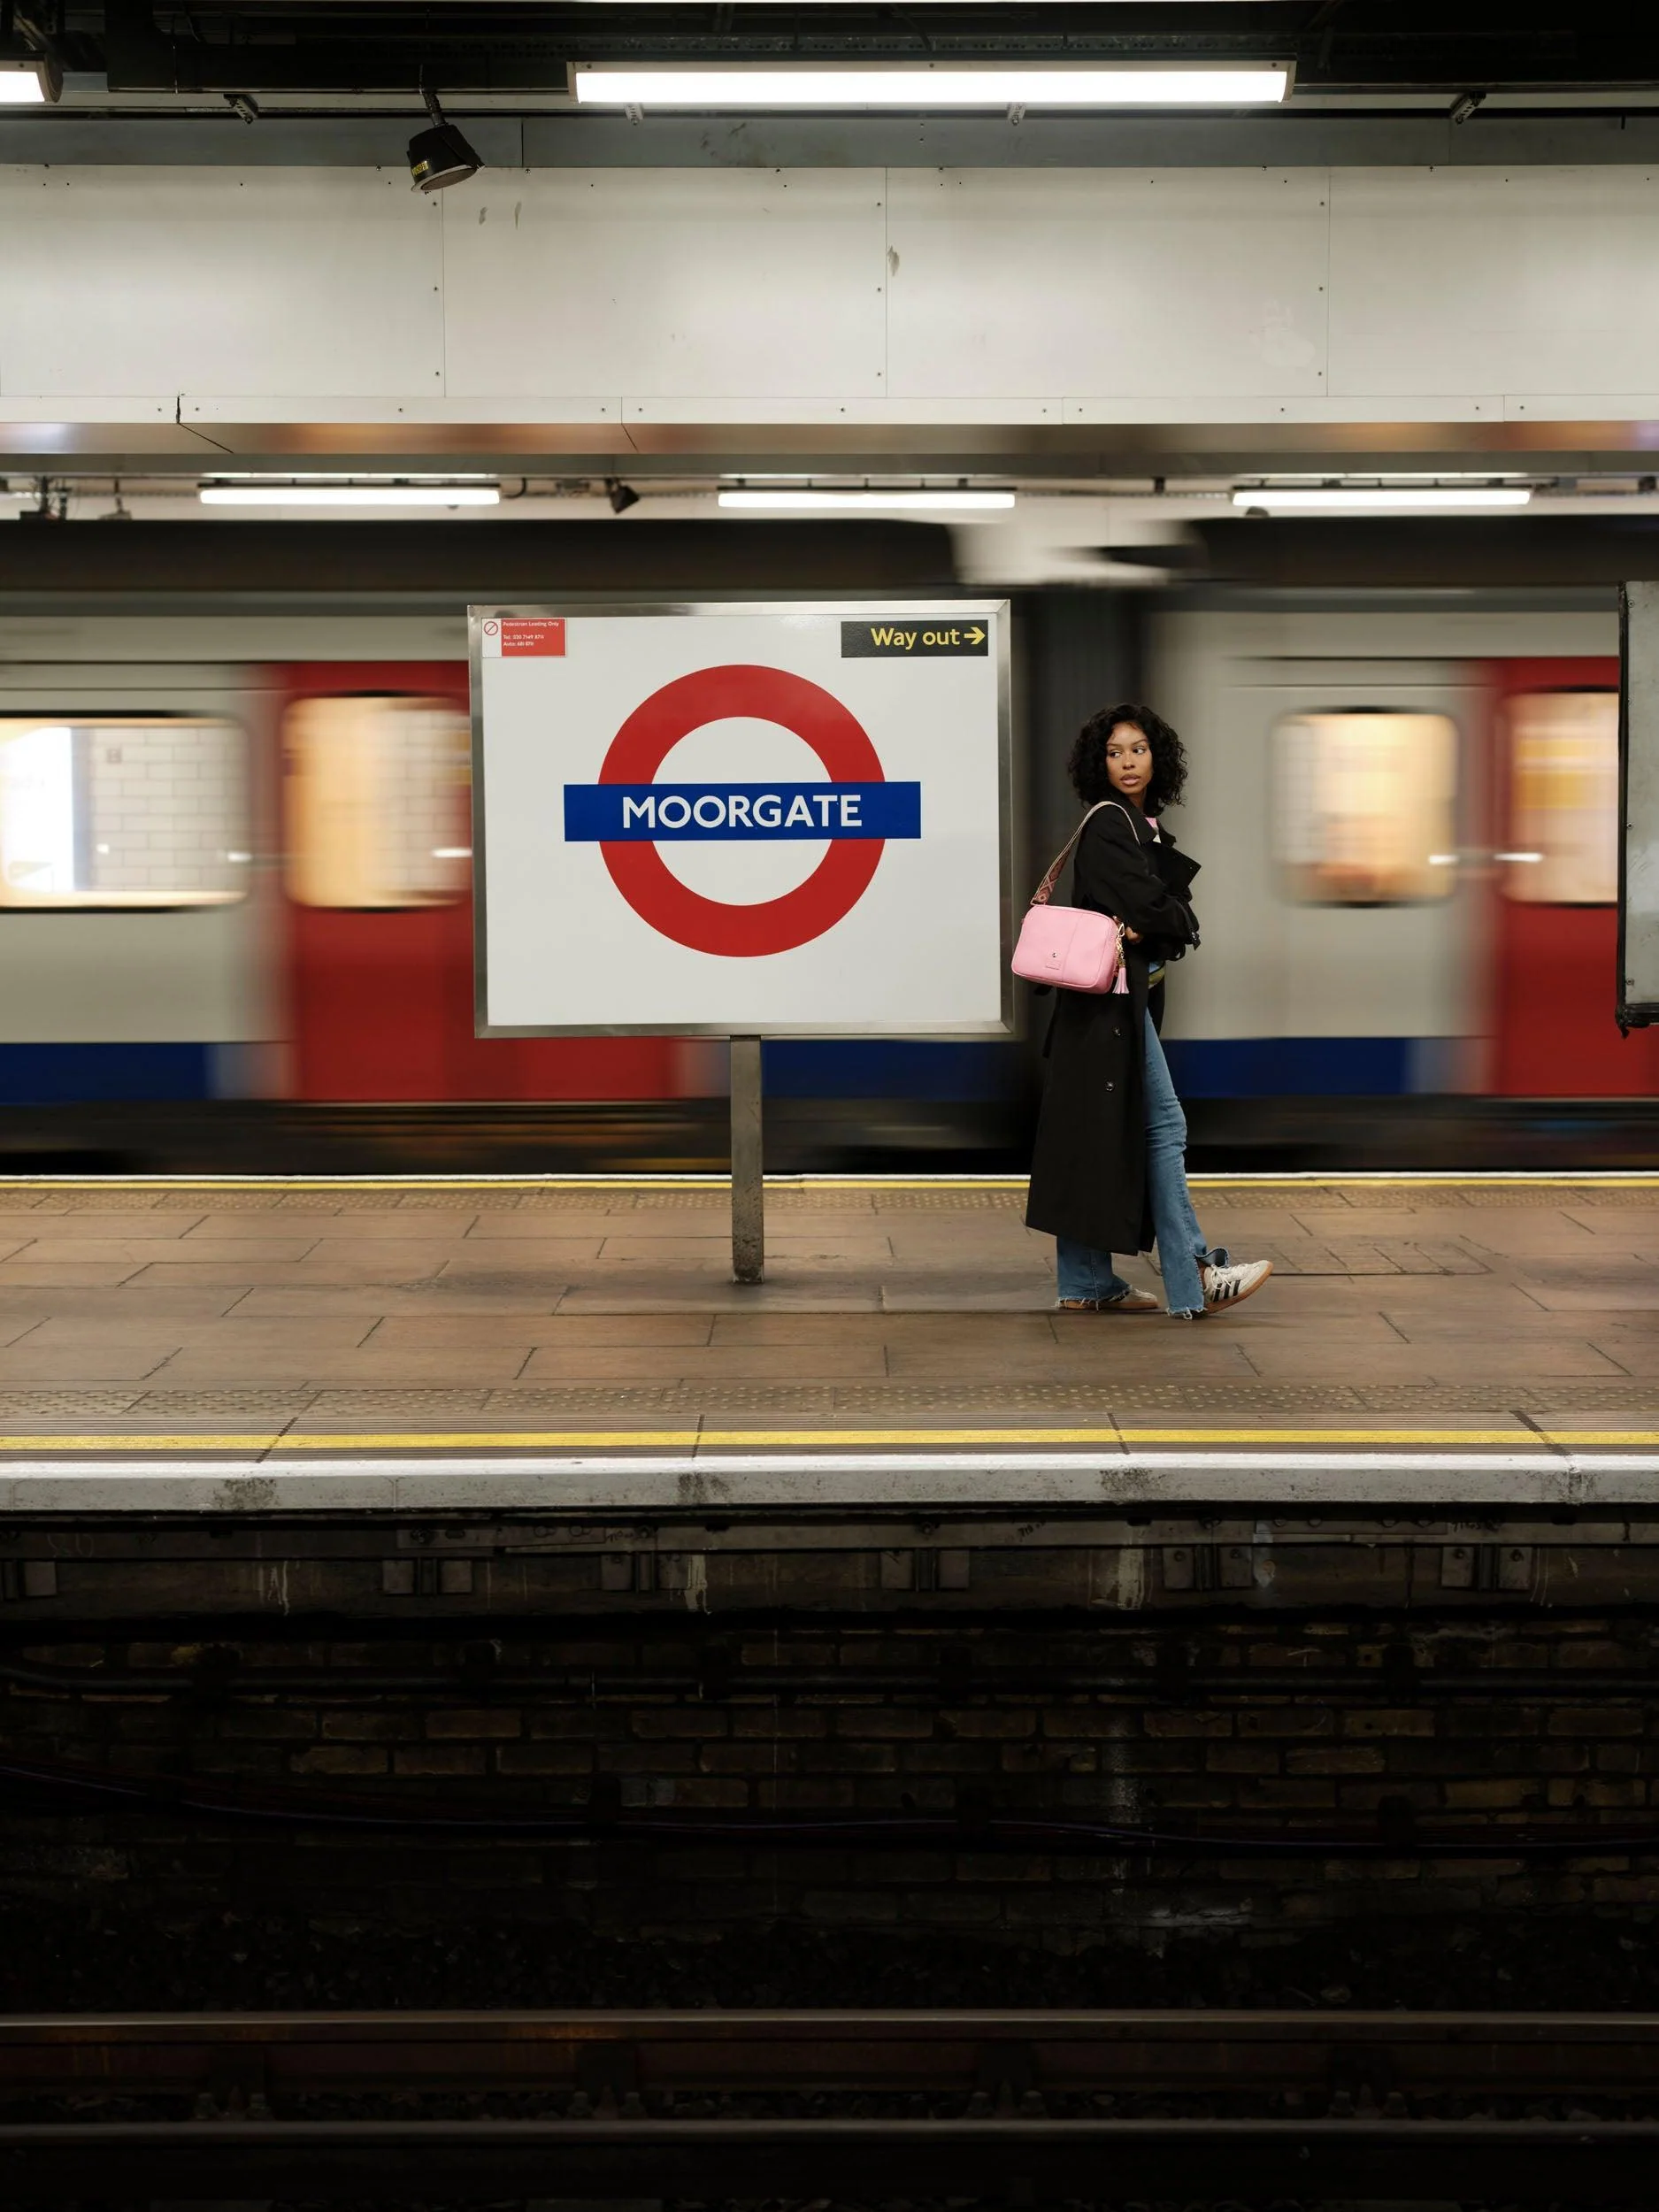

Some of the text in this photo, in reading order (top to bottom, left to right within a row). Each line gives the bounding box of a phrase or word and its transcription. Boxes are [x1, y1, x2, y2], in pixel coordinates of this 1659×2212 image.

[870, 627, 960, 650] Way out
[622, 795, 863, 829] MOORGATE
